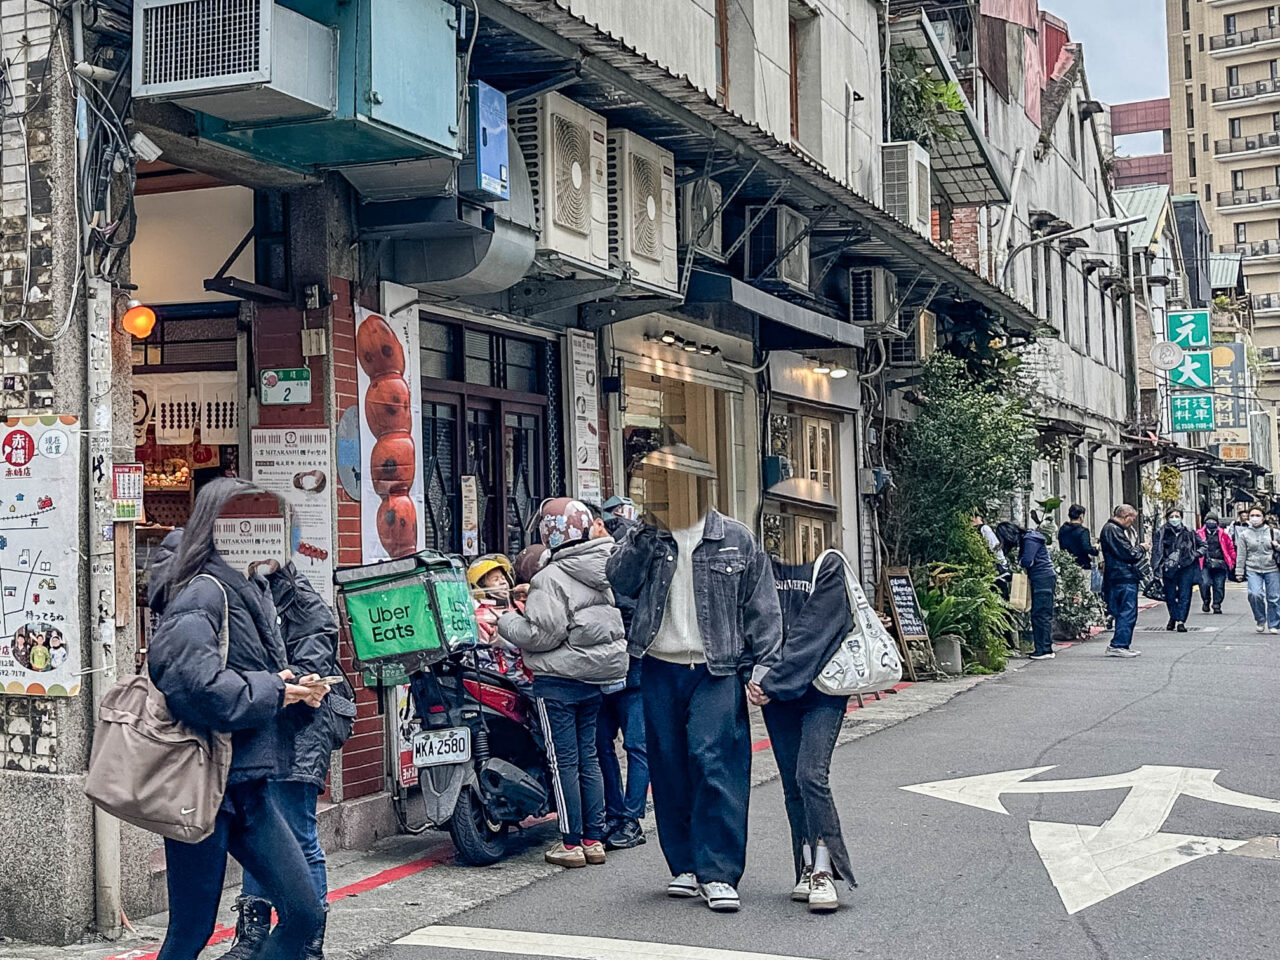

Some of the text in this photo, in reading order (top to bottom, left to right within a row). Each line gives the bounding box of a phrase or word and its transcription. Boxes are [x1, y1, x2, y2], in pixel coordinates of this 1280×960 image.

[283, 387, 291, 401] 2
[1174, 398, 1193, 421] 材料
[45, 436, 61, 445] 現在
[45, 445, 61, 454] 位置
[369, 605, 411, 624] Uber
[372, 623, 415, 643] Eats
[415, 736, 466, 759] MKA-2580
